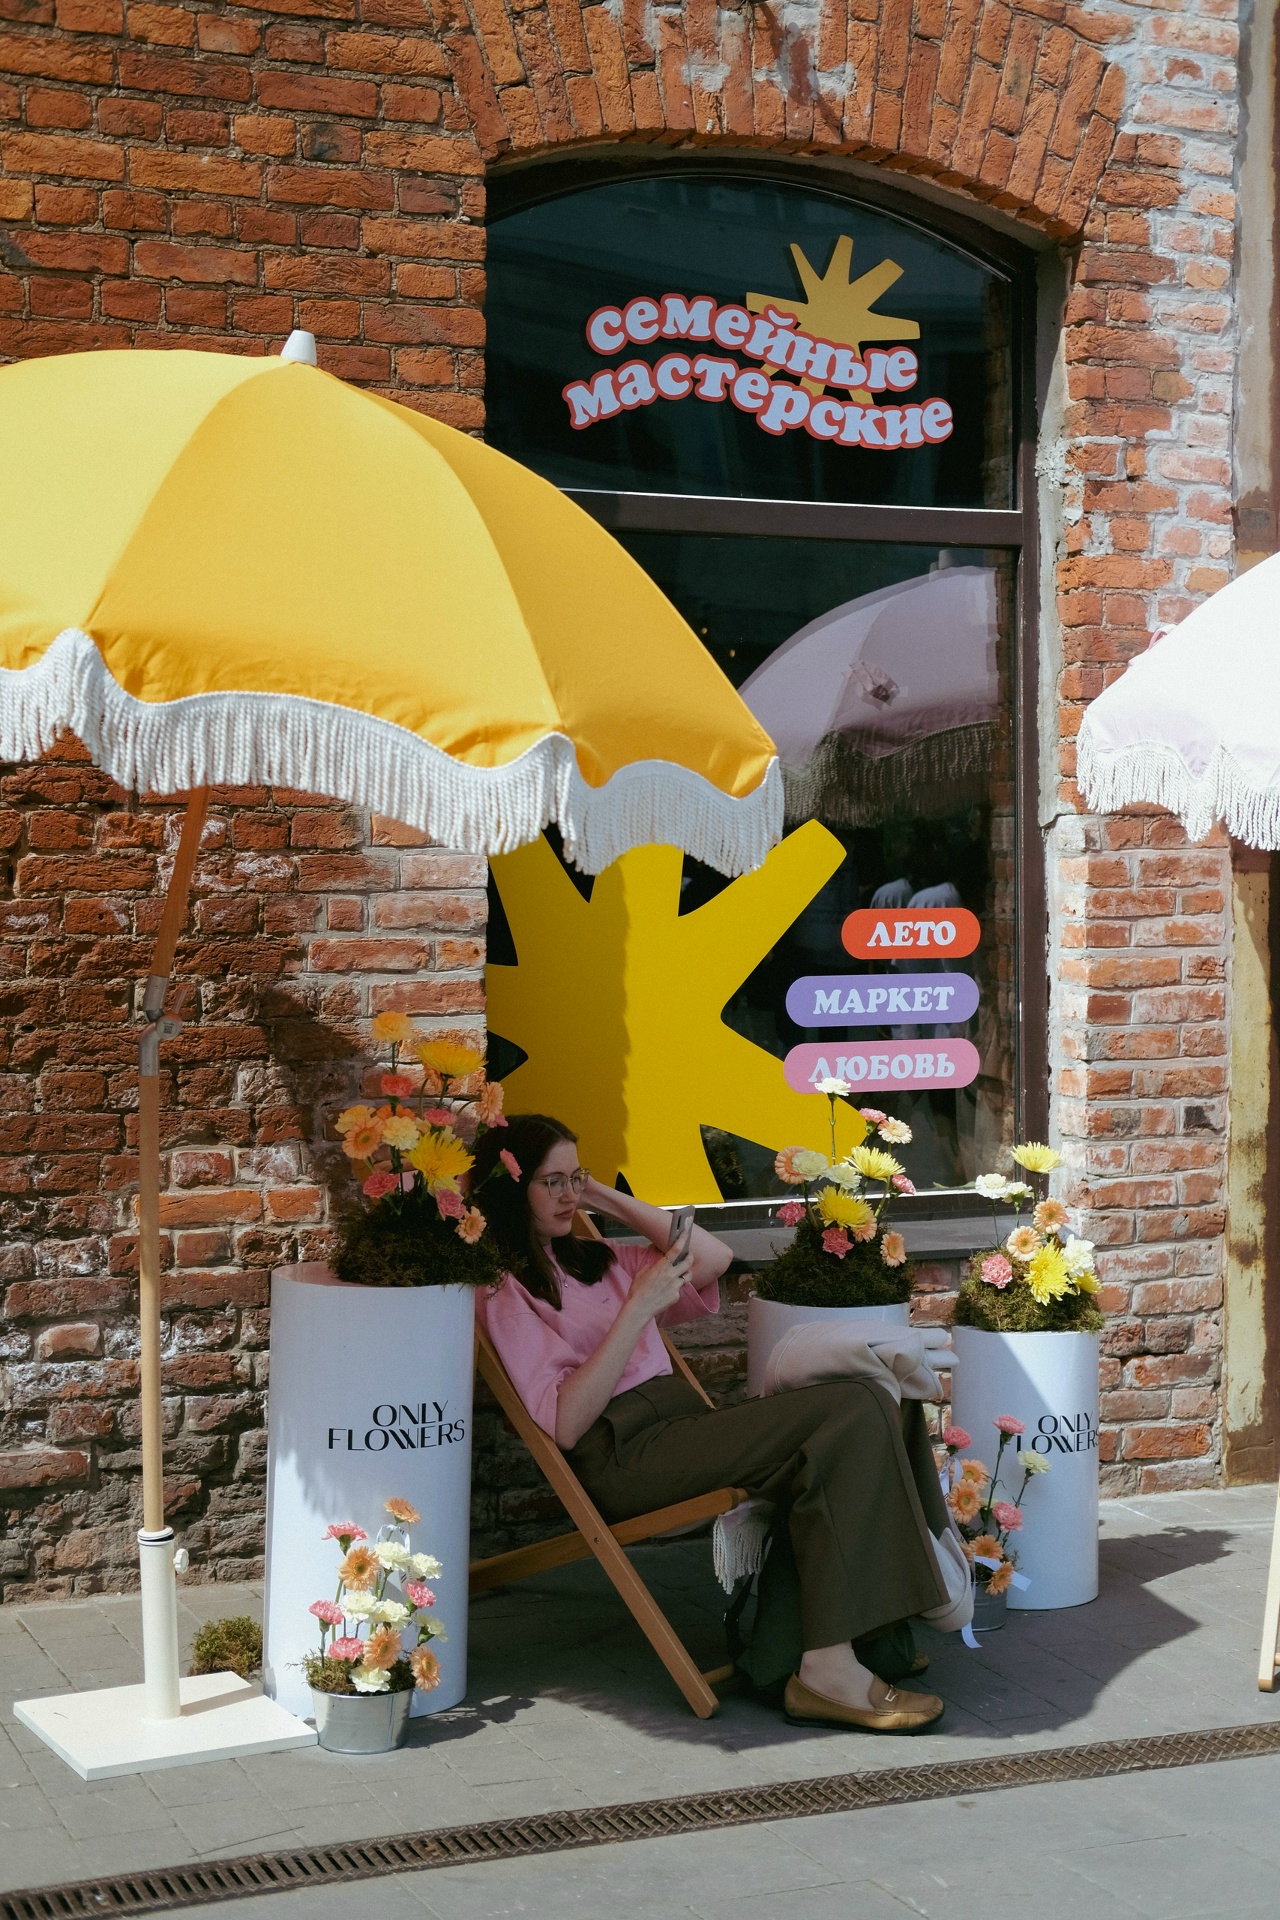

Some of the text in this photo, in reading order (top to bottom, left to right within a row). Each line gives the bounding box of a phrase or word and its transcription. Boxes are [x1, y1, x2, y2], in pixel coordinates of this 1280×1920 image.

[589, 296, 918, 389] семейные
[568, 356, 954, 446] мастерские
[866, 920, 957, 947] ЛЕТО
[812, 986, 956, 1015] МАРКЕТ
[807, 1052, 956, 1083] ЛЮБОВЬ
[372, 1400, 449, 1427] ONLY
[1037, 1411, 1094, 1435] ONLY
[328, 1418, 465, 1451] FLOWERS
